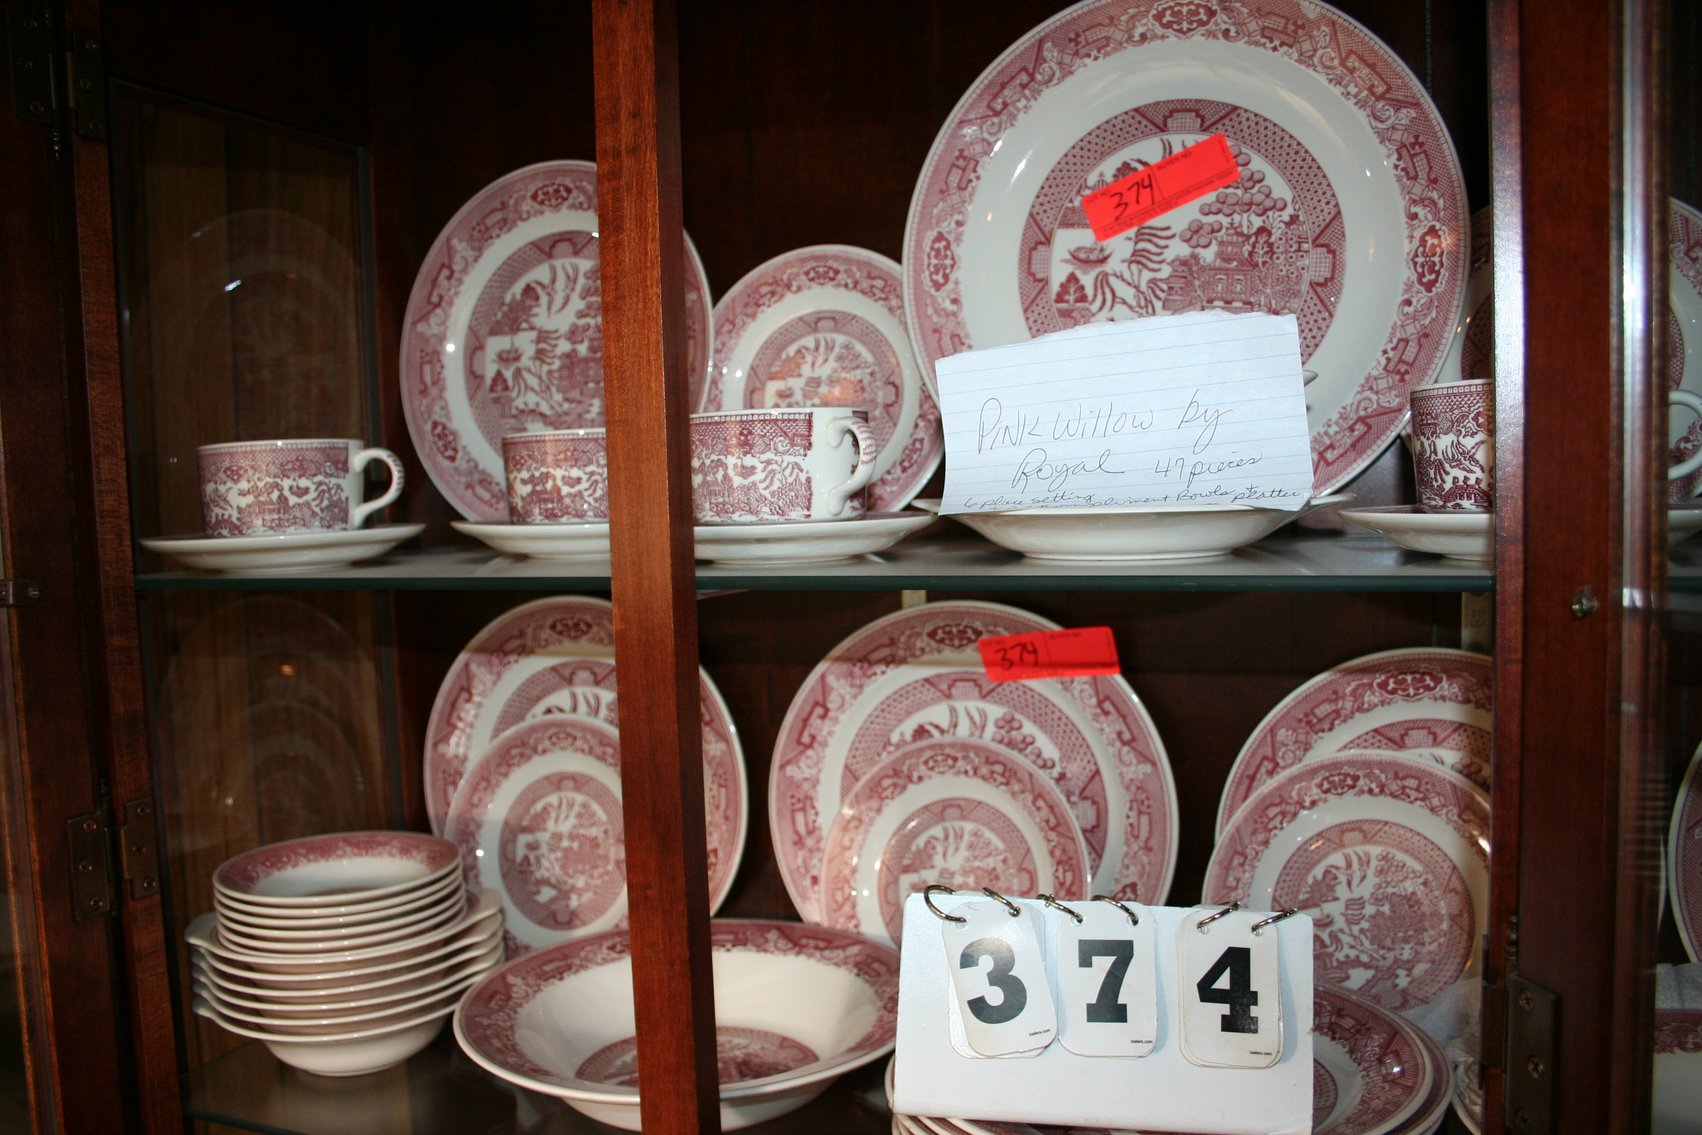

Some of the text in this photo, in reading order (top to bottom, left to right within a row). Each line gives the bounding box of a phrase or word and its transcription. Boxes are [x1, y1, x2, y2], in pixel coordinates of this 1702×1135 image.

[1110, 173, 1155, 221] 374
[1053, 401, 1153, 440] Willow
[1011, 448, 1263, 494] Royal 47 pieces
[995, 641, 1039, 671] 374
[959, 936, 1259, 1034] 3 7 4
